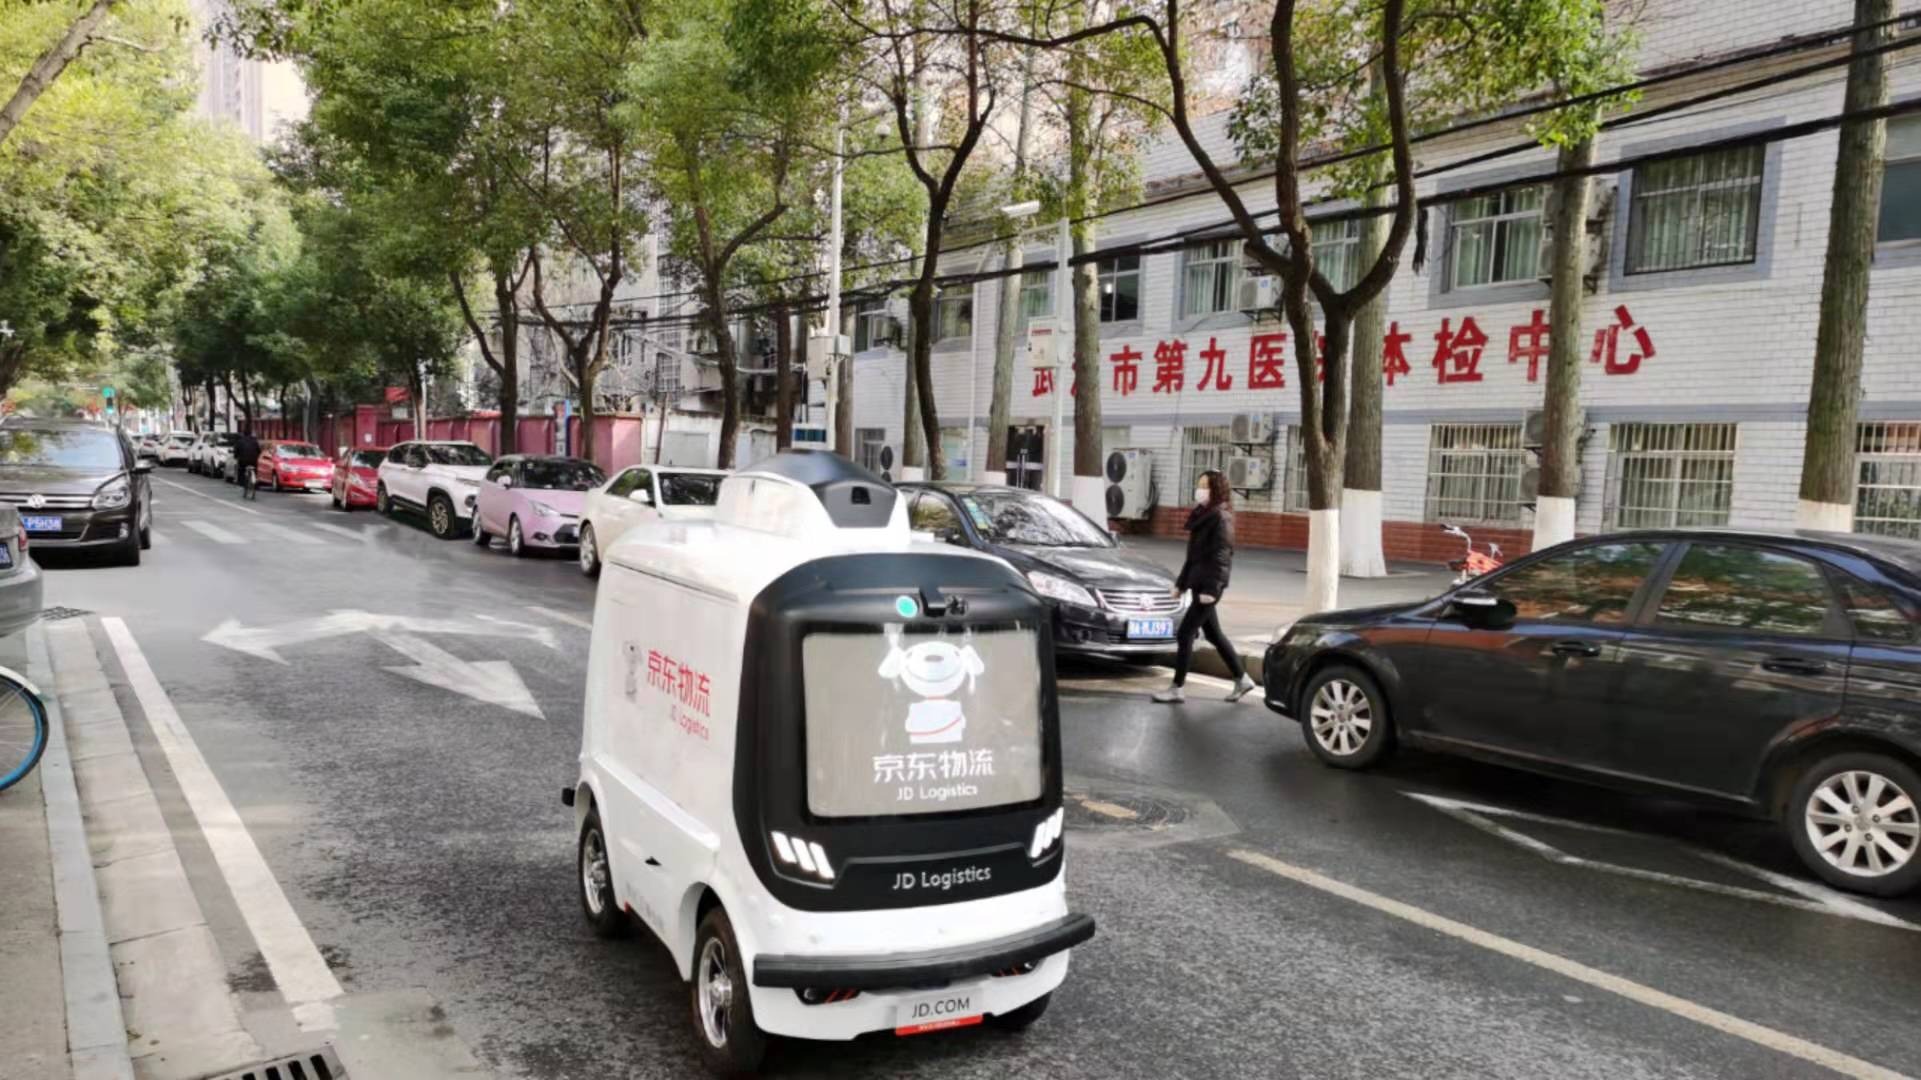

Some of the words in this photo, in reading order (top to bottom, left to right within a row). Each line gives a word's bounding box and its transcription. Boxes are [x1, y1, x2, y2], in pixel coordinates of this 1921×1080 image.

[1031, 304, 1656, 398] 武市第九医体检中心
[647, 649, 711, 717] 京东物流
[872, 749, 995, 784] 京东物流
[896, 786, 914, 801] JD
[919, 782, 979, 801] Logistics
[892, 872, 917, 891] JD
[921, 865, 992, 891] Logistics
[911, 996, 970, 1019] JD.COM
